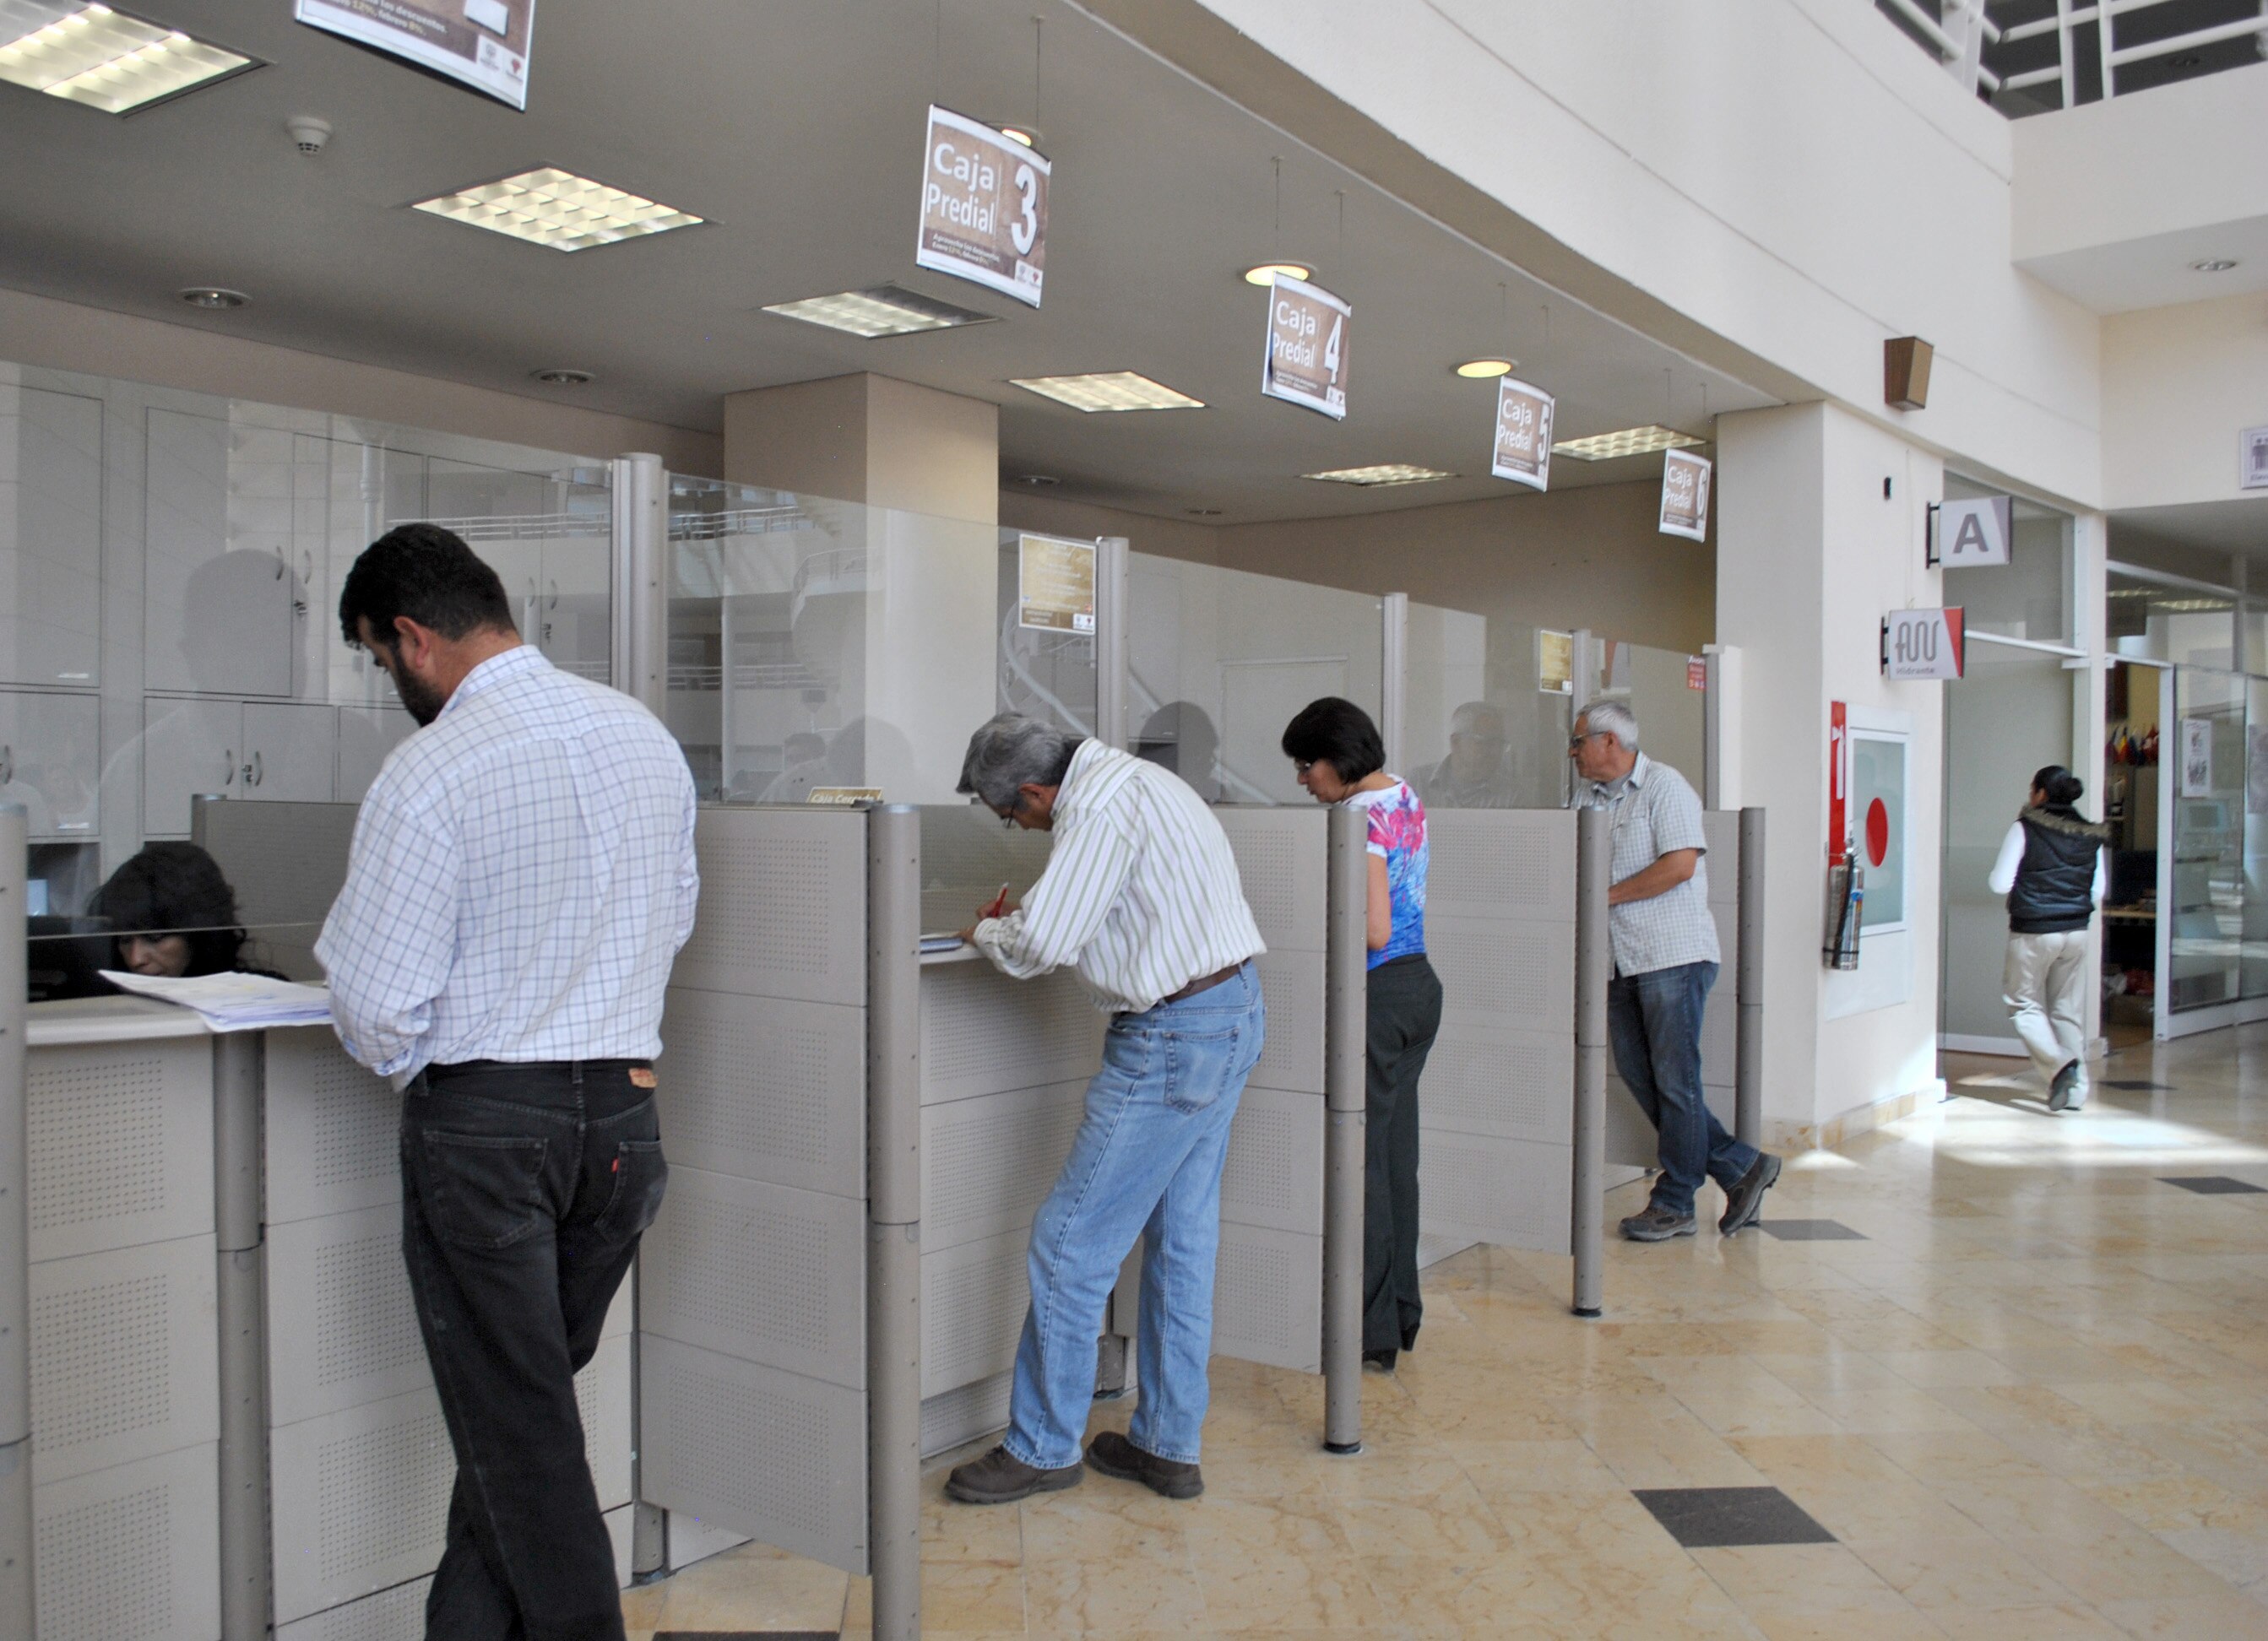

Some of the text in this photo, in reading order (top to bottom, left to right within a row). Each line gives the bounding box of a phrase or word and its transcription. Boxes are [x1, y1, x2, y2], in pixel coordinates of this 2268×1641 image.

[934, 143, 994, 192] Caja
[927, 183, 996, 235] Predial
[1011, 164, 1037, 255] 3
[1276, 301, 1316, 337] Caja
[1272, 332, 1316, 369] Predial
[1324, 313, 1343, 384] 4
[1502, 398, 1533, 427] Caja
[1498, 424, 1533, 452] Predial
[1537, 403, 1550, 462] 5
[1668, 465, 1692, 490] Caja
[1696, 468, 1706, 517] 6
[1665, 487, 1692, 510] Predial
[1952, 513, 1989, 554] A
[811, 794, 833, 804] Caja
